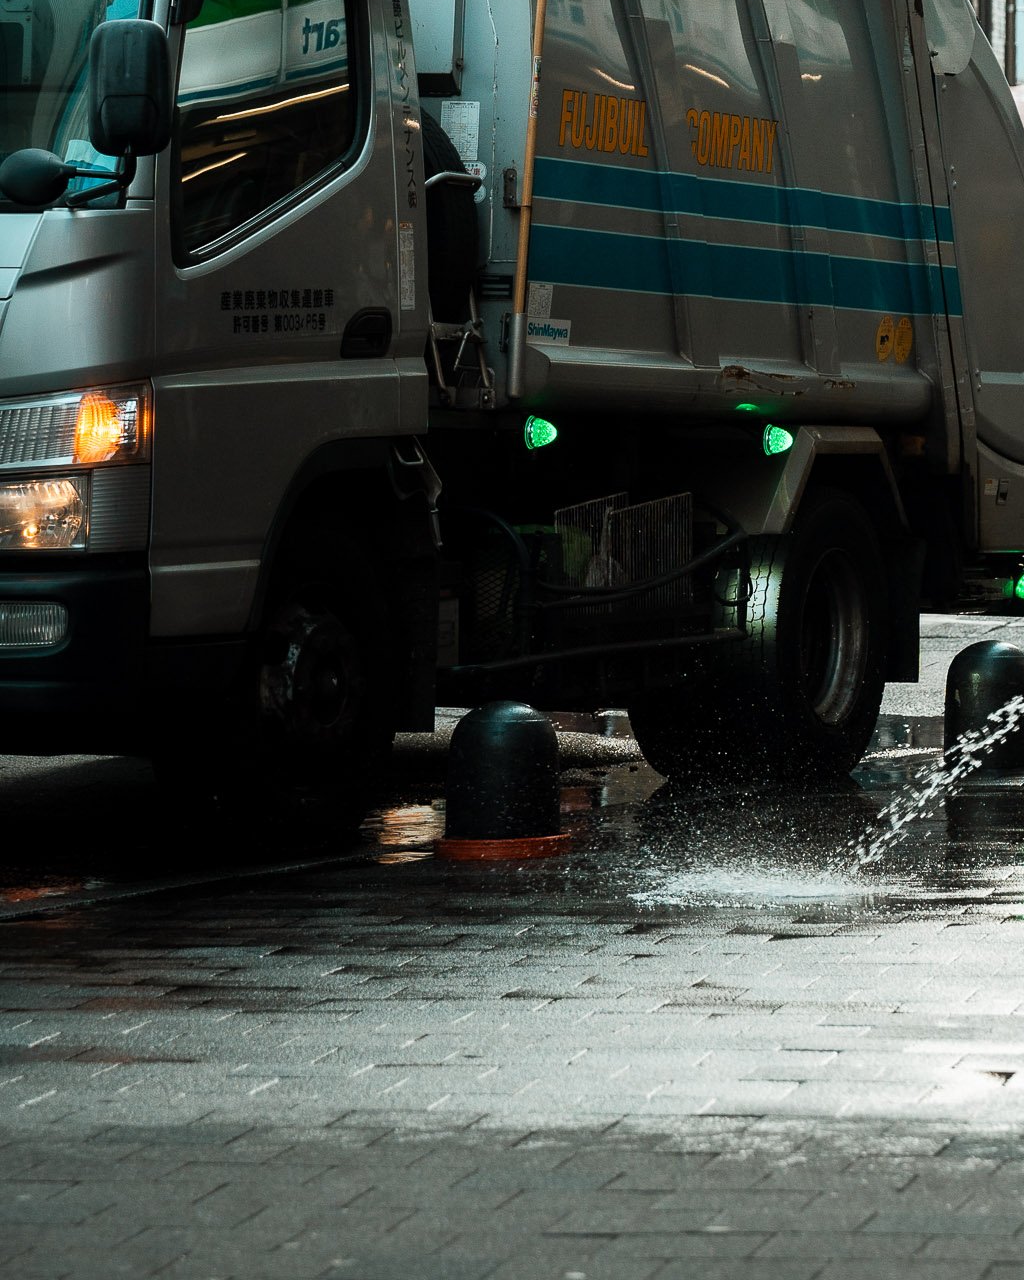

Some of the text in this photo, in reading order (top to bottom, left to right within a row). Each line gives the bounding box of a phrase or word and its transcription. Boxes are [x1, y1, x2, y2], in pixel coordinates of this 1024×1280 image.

[687, 108, 780, 174] COMPANY
[221, 288, 334, 310] 産業廃棄物収集運搬車
[233, 314, 268, 333] 許可番号
[527, 322, 568, 340] ShinMaywa
